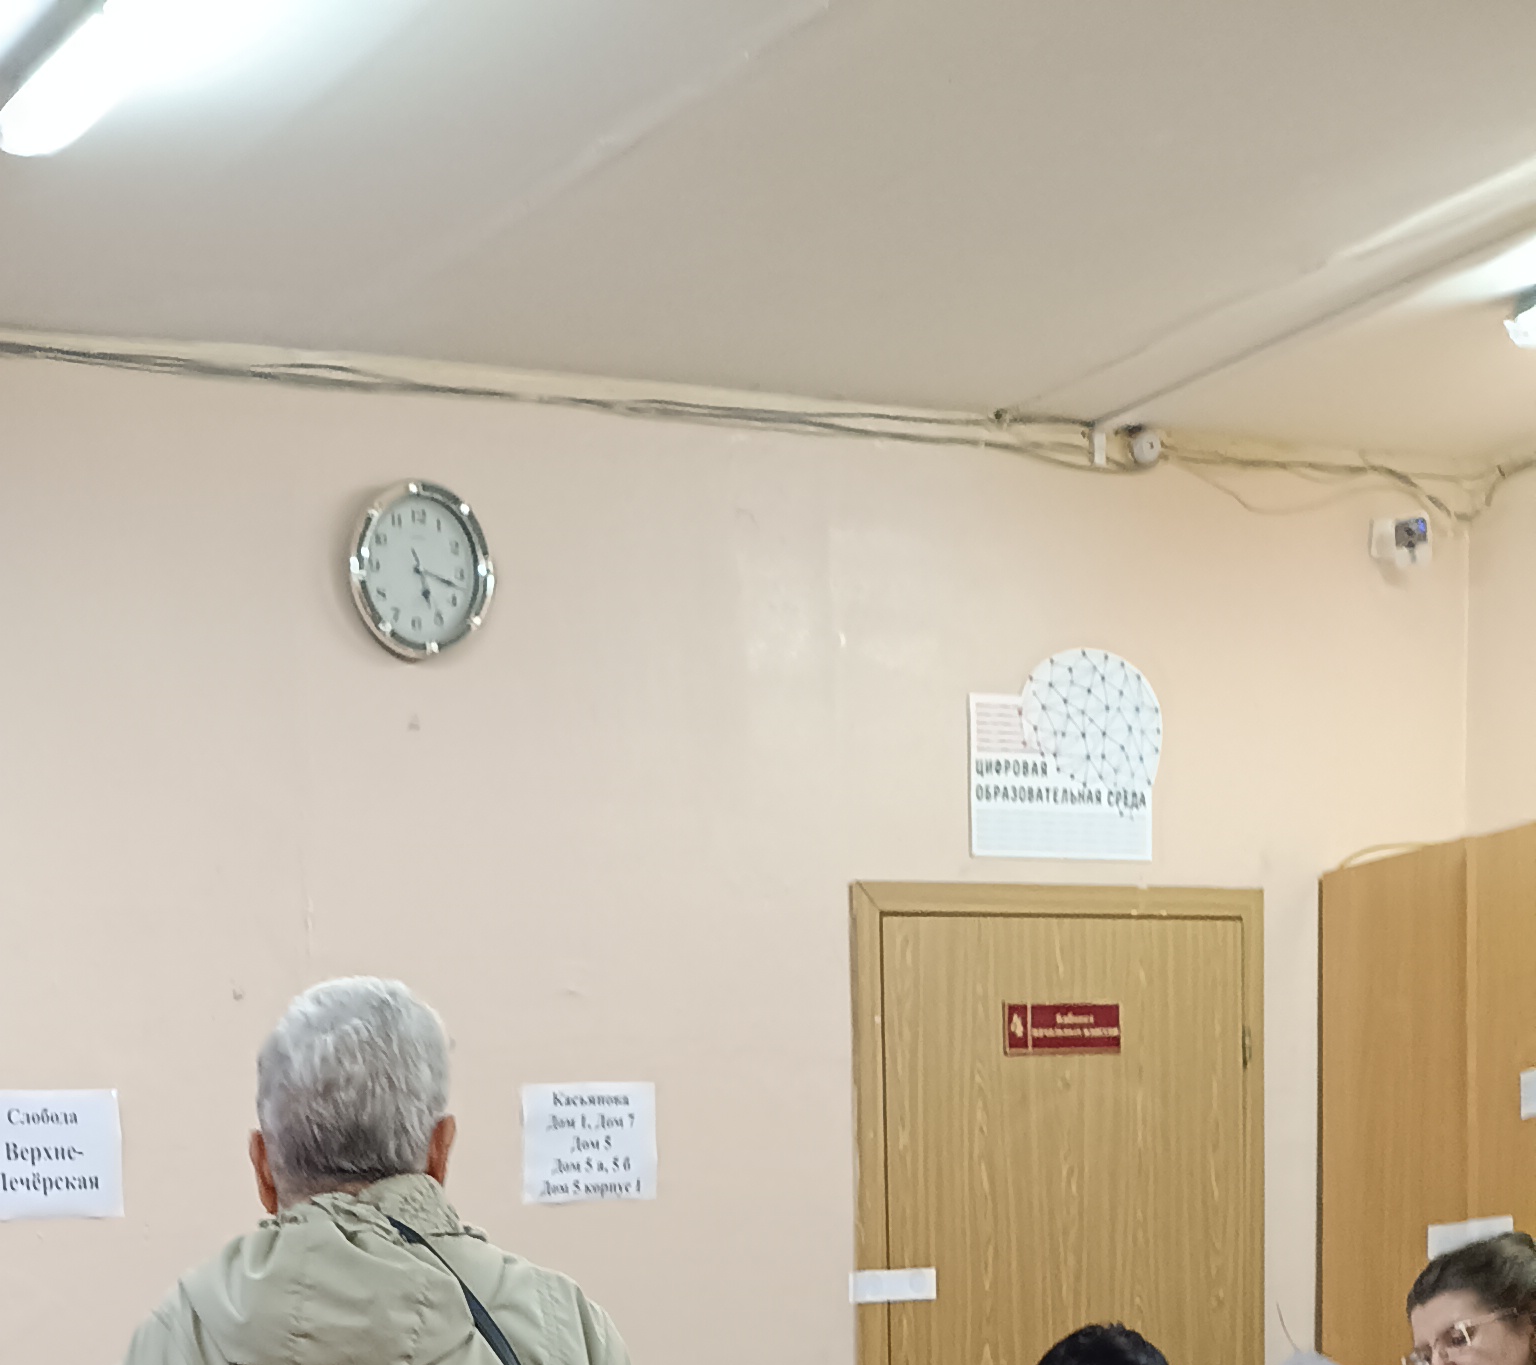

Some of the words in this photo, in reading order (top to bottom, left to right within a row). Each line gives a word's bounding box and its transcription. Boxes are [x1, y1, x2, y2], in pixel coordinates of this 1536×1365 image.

[975, 759, 1048, 777] ЦИФРОВАЯ
[975, 783, 1102, 805] ОБРАЗОВАТЕЛЬНАЯ
[1107, 787, 1147, 809] СРЕДА
[7, 1108, 78, 1126] Слобода
[546, 1112, 576, 1131] Дом
[594, 1112, 624, 1131] Дом
[570, 1134, 600, 1154] Дом
[603, 1134, 612, 1152] 5
[5, 1141, 84, 1167] Верхне-
[550, 1157, 581, 1176] Дом
